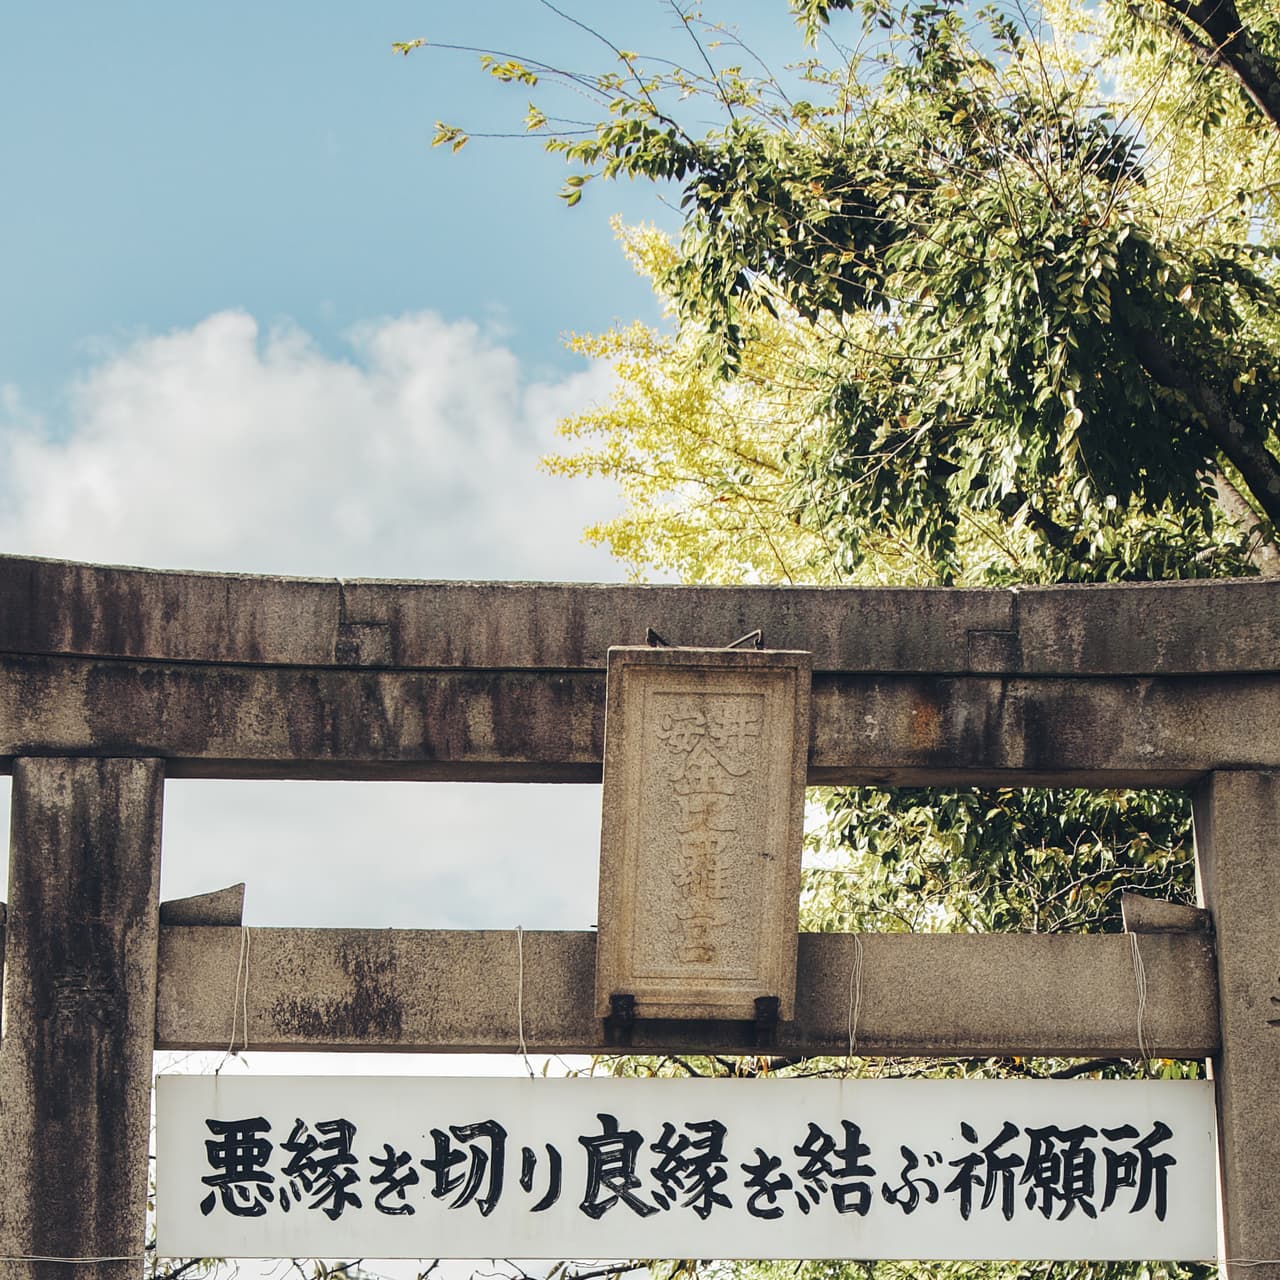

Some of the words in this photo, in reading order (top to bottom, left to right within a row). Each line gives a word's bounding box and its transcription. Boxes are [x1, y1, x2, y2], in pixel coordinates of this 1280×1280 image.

[199, 1111, 1178, 1223] 悪縁を切り良縁を結ぶ祈願所
